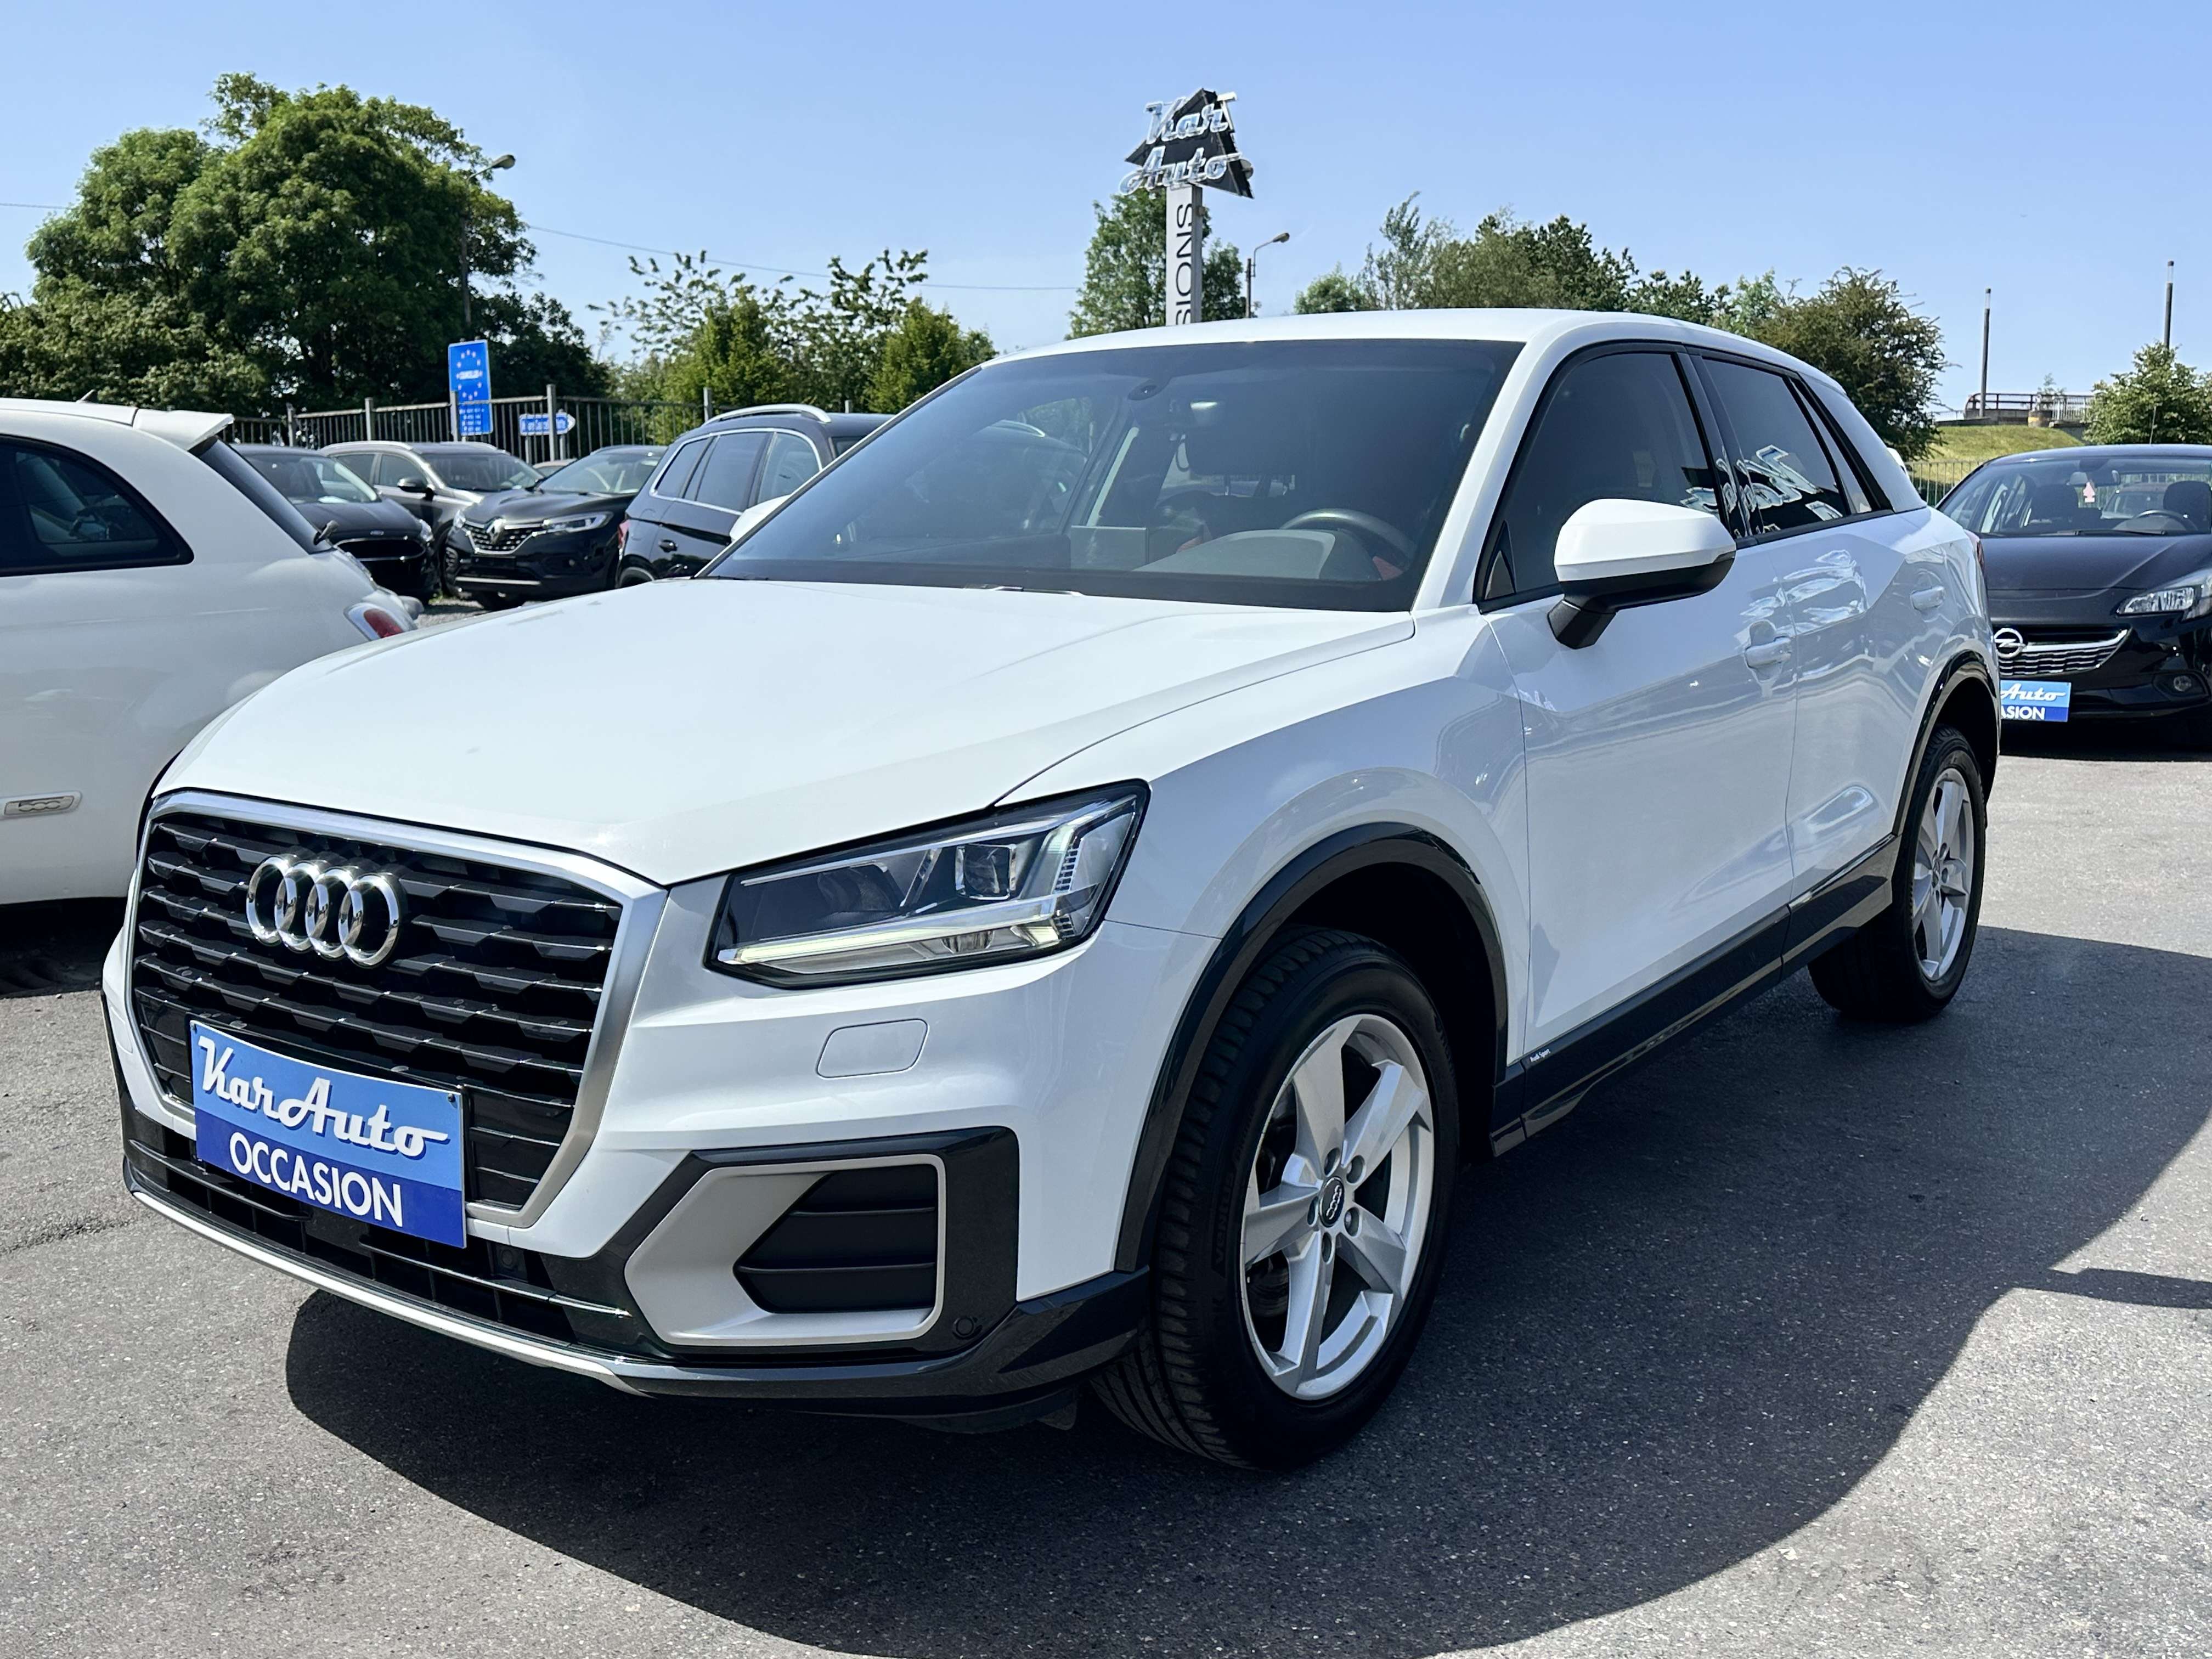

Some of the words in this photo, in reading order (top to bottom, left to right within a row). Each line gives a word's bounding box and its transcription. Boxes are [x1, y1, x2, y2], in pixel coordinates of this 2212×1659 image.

[1119, 145, 1242, 195] Auto
[18, 800, 60, 812] 500
[229, 1132, 403, 1227] OCCASION
